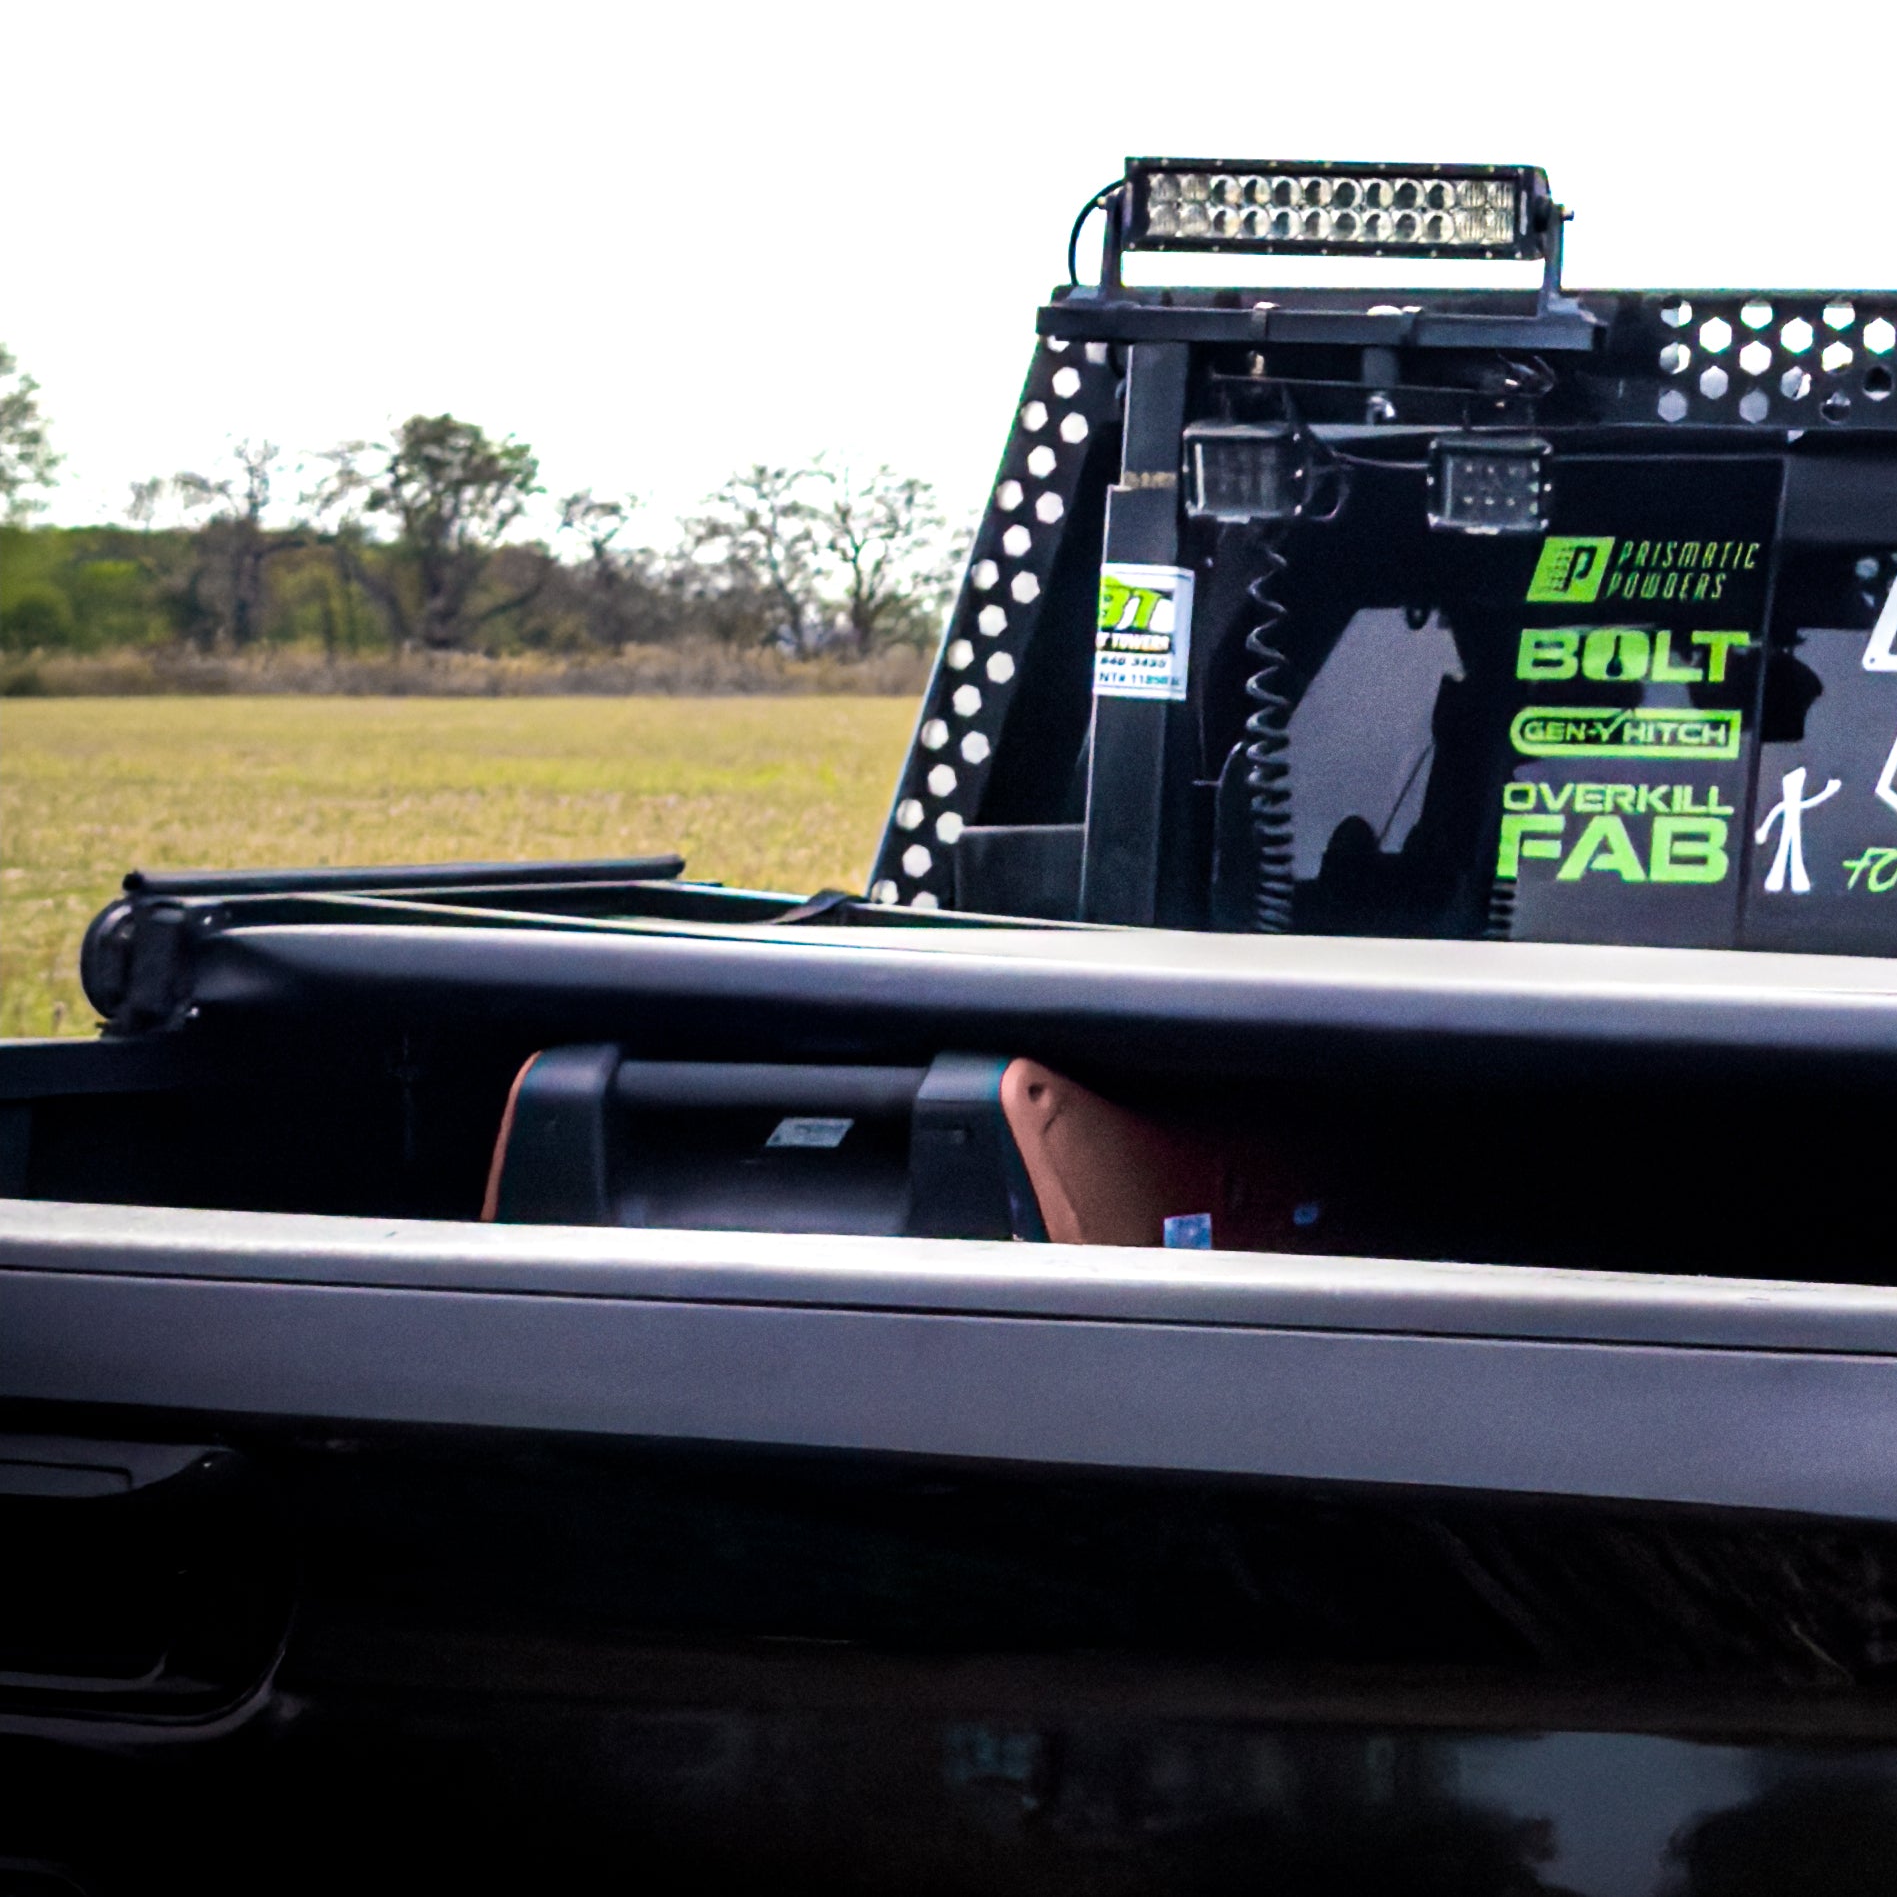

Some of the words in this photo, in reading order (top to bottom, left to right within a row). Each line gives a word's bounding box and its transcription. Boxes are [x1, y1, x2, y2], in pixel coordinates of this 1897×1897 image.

[1617, 540, 1761, 569] PRISMATIC
[1604, 570, 1728, 600] POWDERS
[1516, 629, 1750, 683] BOLT
[1523, 717, 1618, 743] GEN-Y
[1623, 721, 1728, 746] HITCH
[1504, 781, 1735, 816] OVERKILL
[1497, 813, 1730, 884] FAB
